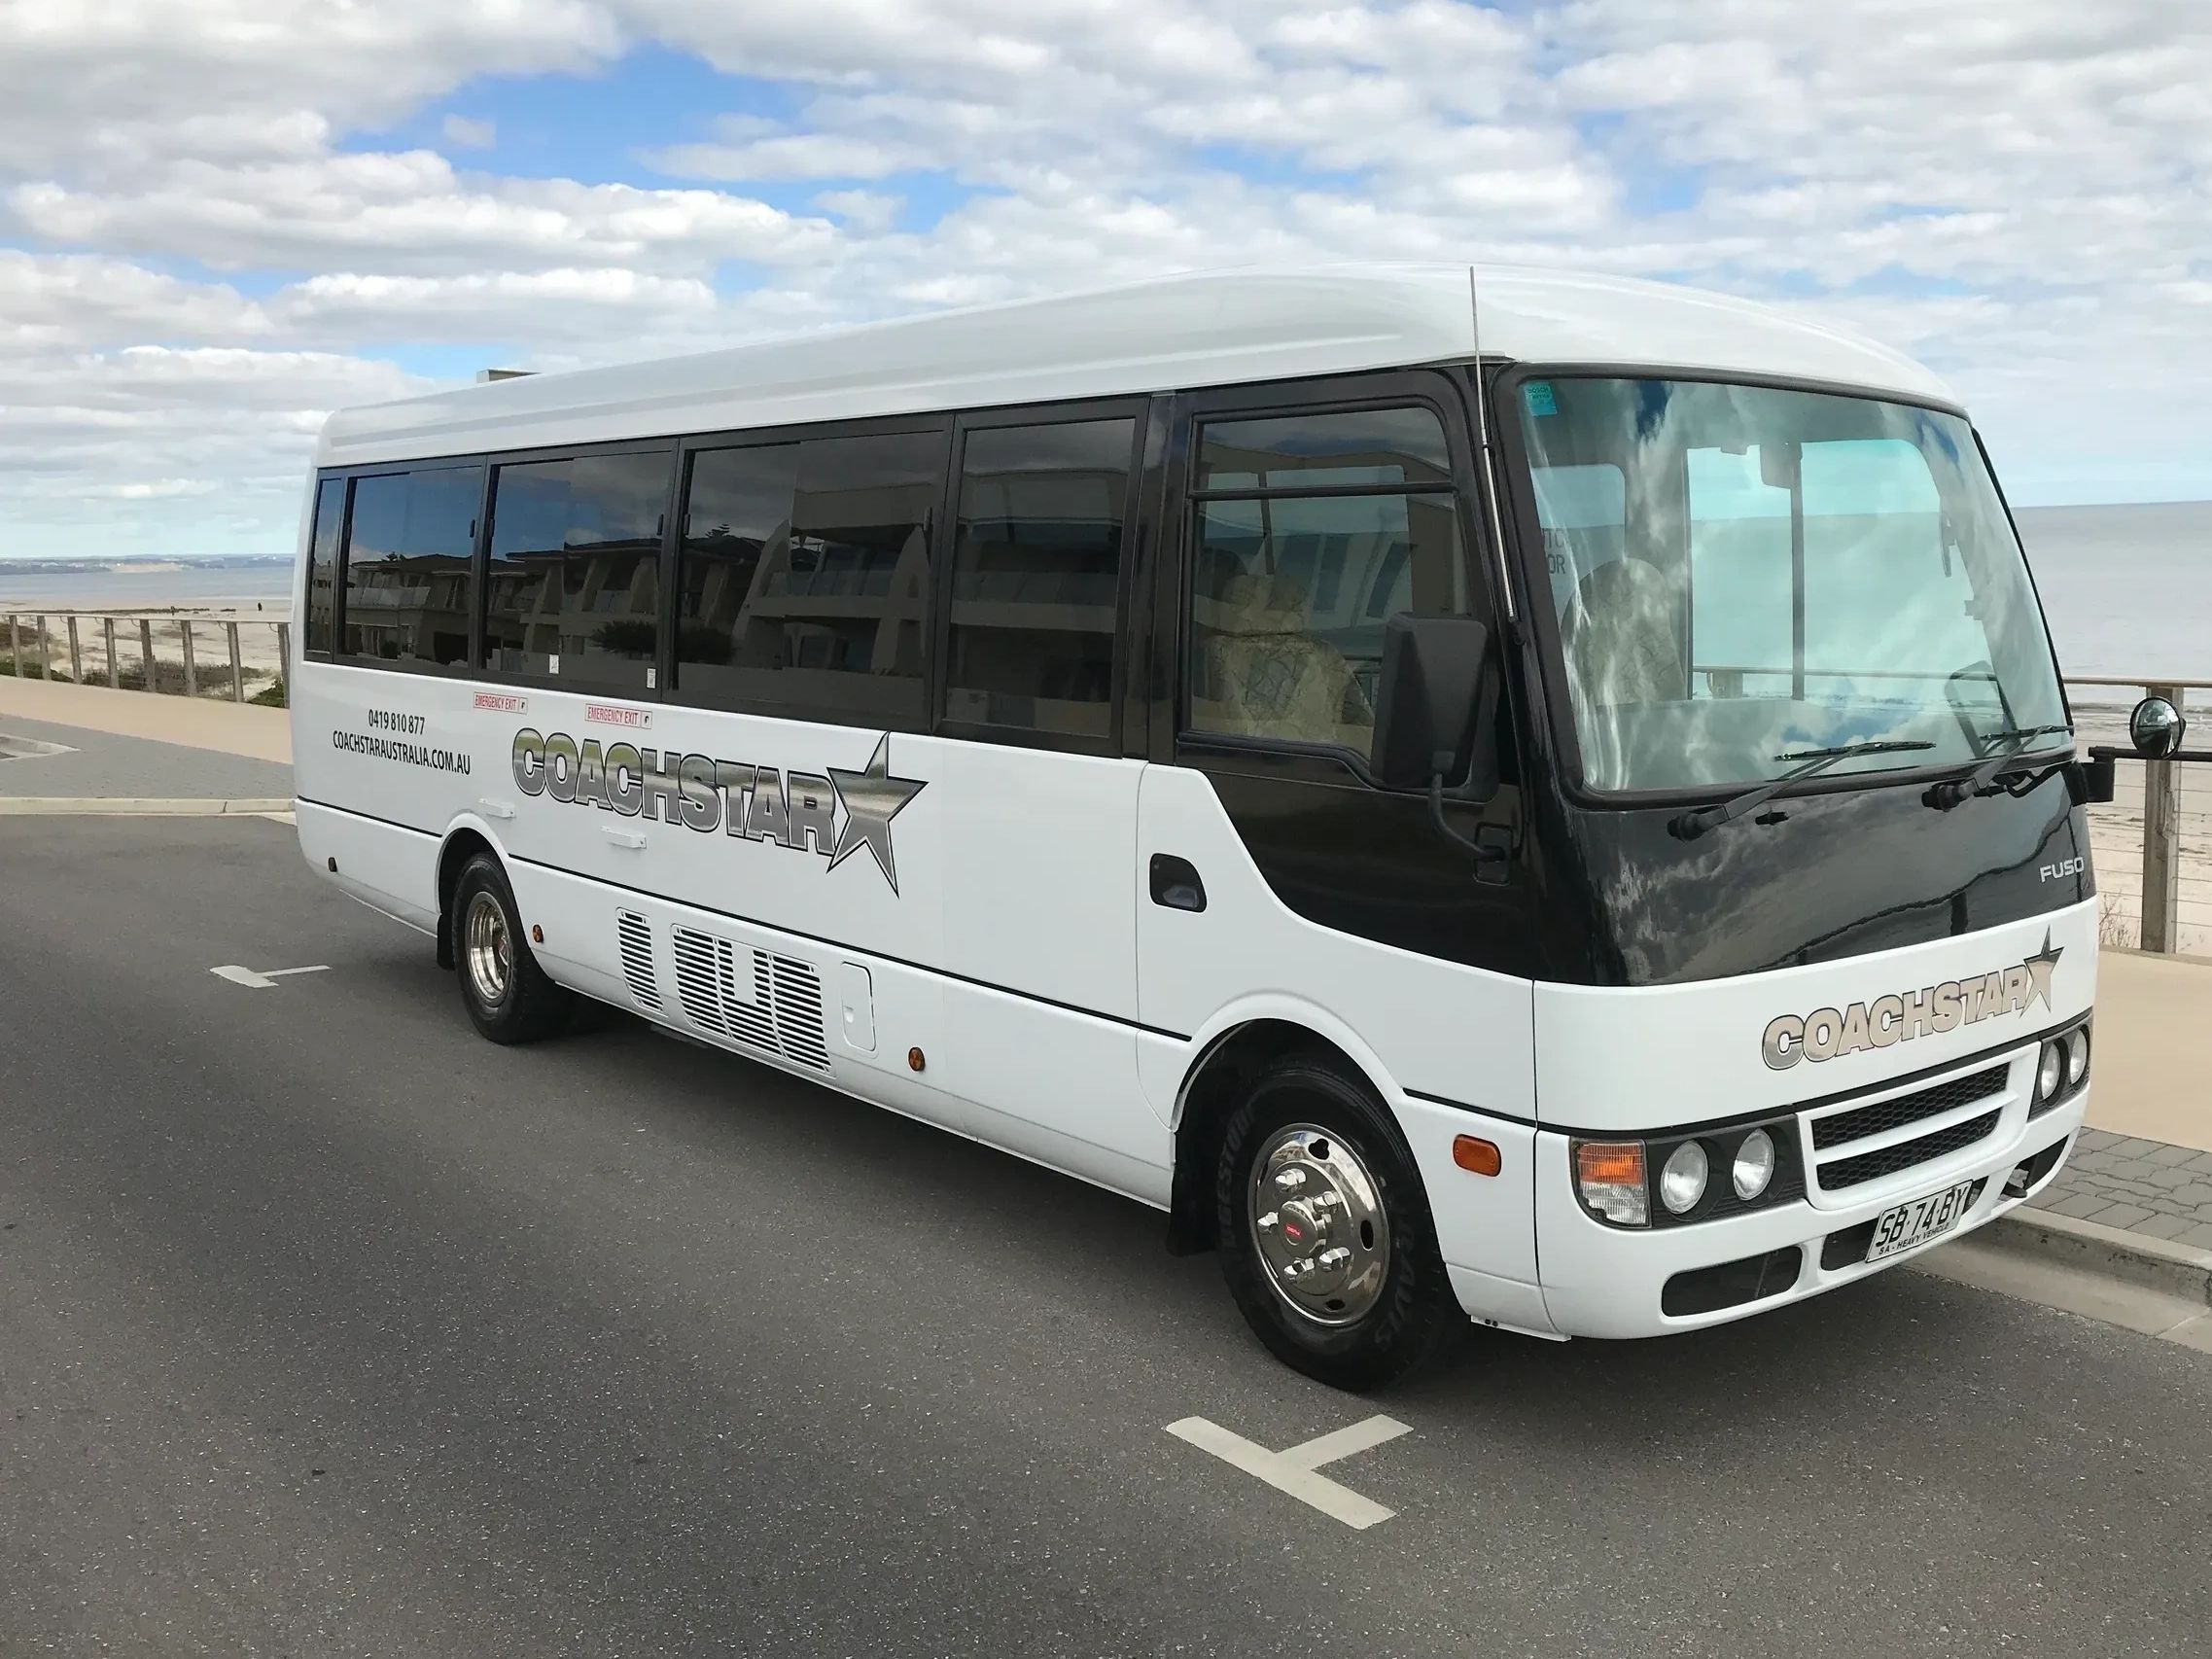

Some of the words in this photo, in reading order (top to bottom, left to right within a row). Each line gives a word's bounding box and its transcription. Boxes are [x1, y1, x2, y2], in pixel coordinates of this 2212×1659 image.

[474, 694, 504, 708] EMERGENCY
[505, 698, 517, 710] EXIT
[368, 708, 389, 730] 0419
[390, 712, 407, 733] 810
[408, 715, 426, 735] 877
[587, 706, 623, 723] EMERGENCY
[624, 711, 639, 725] EXIT
[333, 729, 472, 776] COACHSTARAUSTRALIA.COM.AU
[512, 727, 839, 858] COACHSTAR
[2039, 857, 2085, 883] FUSO
[1762, 964, 2032, 1071] COACHSTAR
[1878, 1246, 1890, 1255] SA
[1896, 1234, 1921, 1250] HEAVY
